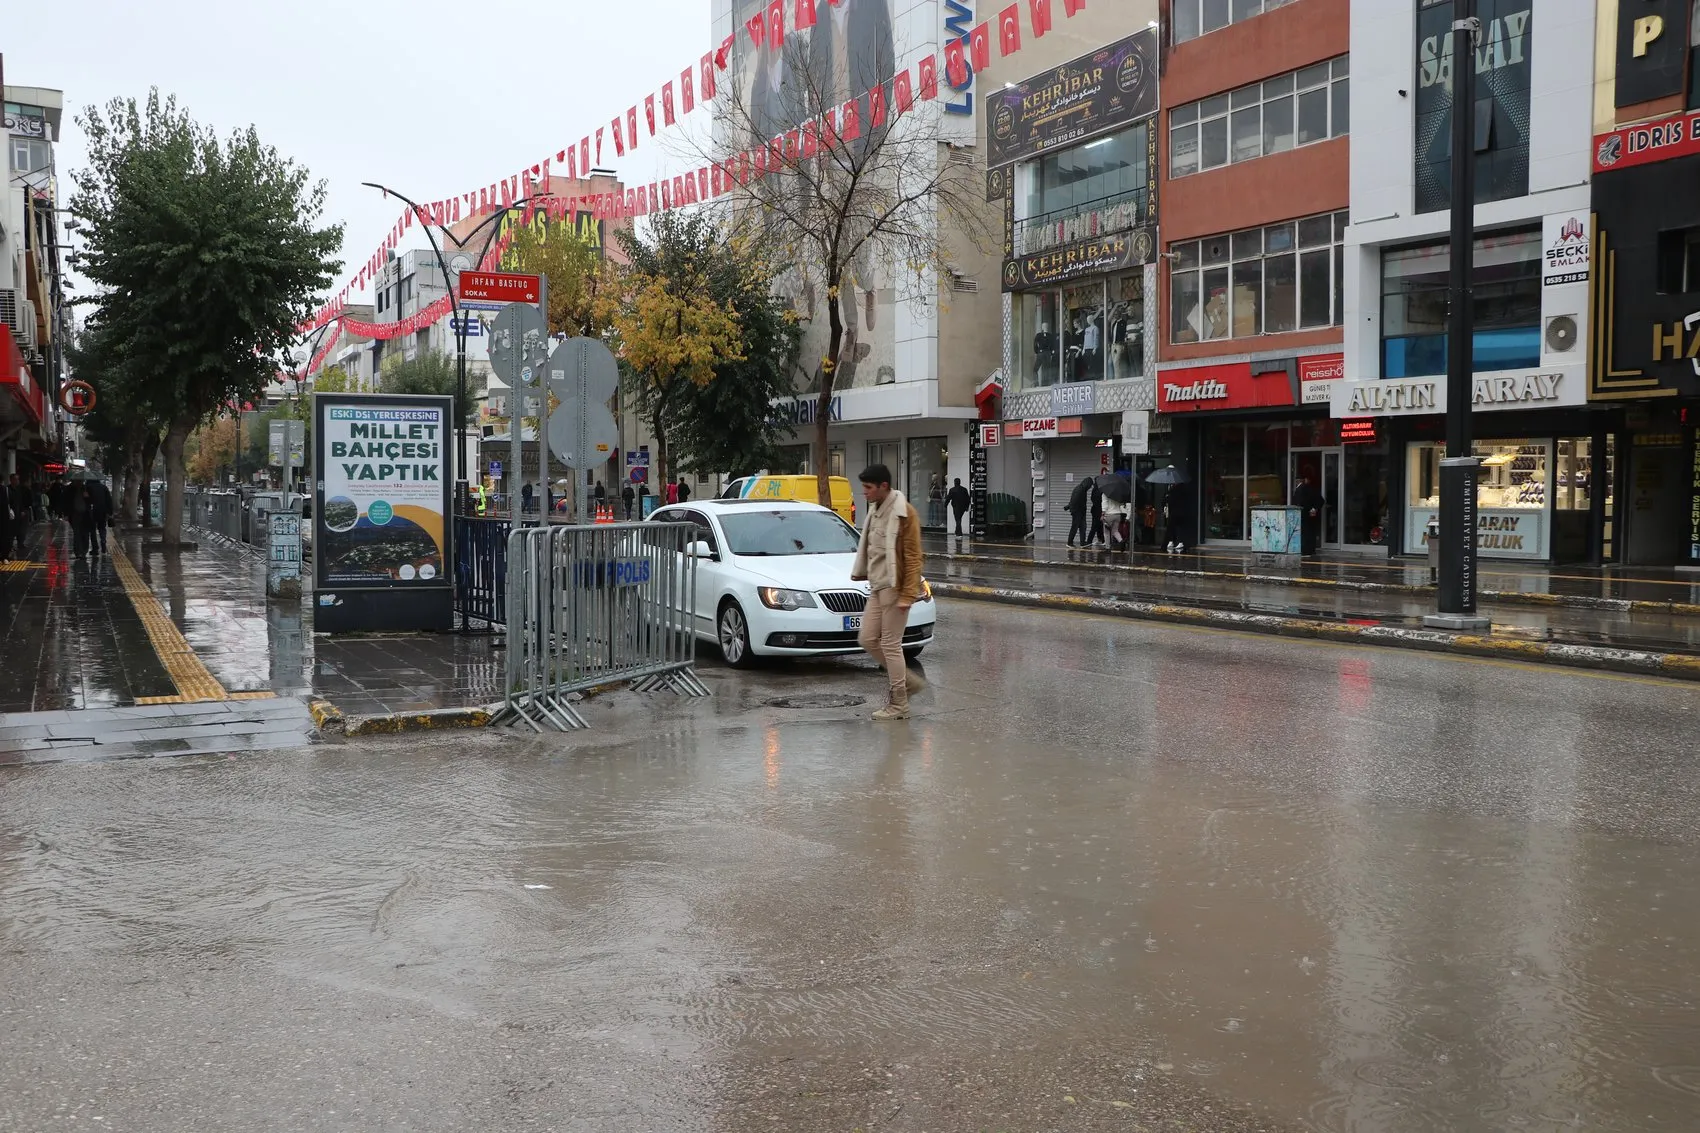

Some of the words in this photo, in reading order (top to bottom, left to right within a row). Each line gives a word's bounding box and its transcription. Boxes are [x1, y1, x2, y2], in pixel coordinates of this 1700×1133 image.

[1633, 15, 1664, 58] P
[1022, 68, 1104, 111] KEHRİBAR
[1044, 138, 1057, 147] 0553
[1058, 134, 1068, 143] 810
[1077, 127, 1085, 135] 65
[1027, 240, 1125, 272] KEHRİBAR
[1546, 277, 1563, 285] 0535
[1563, 274, 1577, 282] 218
[1053, 385, 1092, 404] MERTER
[1348, 383, 1435, 411] ALTIN
[1471, 373, 1563, 405] ARAY
[350, 423, 438, 440] MİLLET
[1023, 419, 1056, 432] ECZANE
[331, 441, 438, 461] BAHÇESİ
[341, 463, 439, 481] YAPTIK
[850, 616, 861, 628] 66
